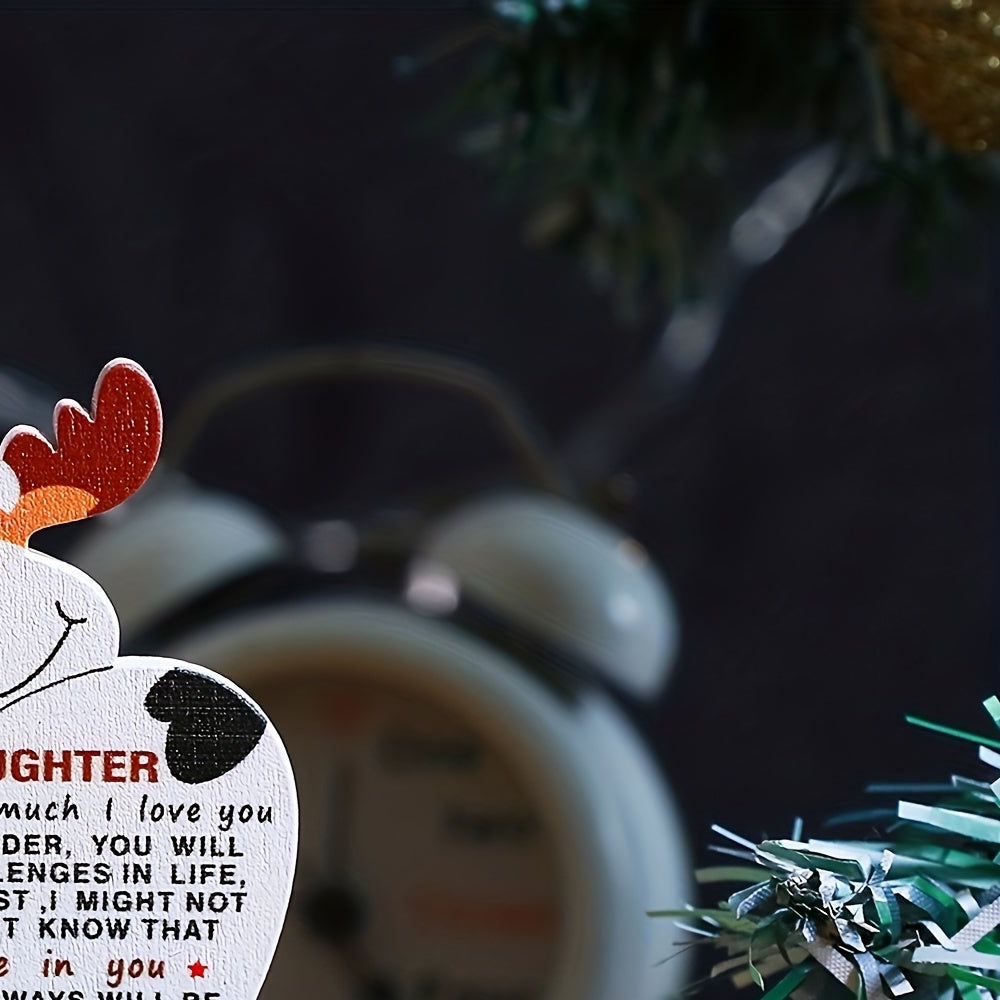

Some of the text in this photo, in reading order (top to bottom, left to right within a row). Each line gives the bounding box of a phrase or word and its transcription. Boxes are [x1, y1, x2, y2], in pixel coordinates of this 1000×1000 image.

[140, 794, 201, 823] love
[218, 804, 273, 831] you
[91, 835, 152, 856] YOU
[171, 836, 244, 857] WILL
[122, 863, 152, 884] IN
[76, 891, 175, 912] MIGHT
[186, 892, 248, 913] NOT
[39, 918, 131, 940] KNOW
[141, 919, 219, 941] THAT
[43, 949, 75, 978] in
[107, 958, 166, 988] you
